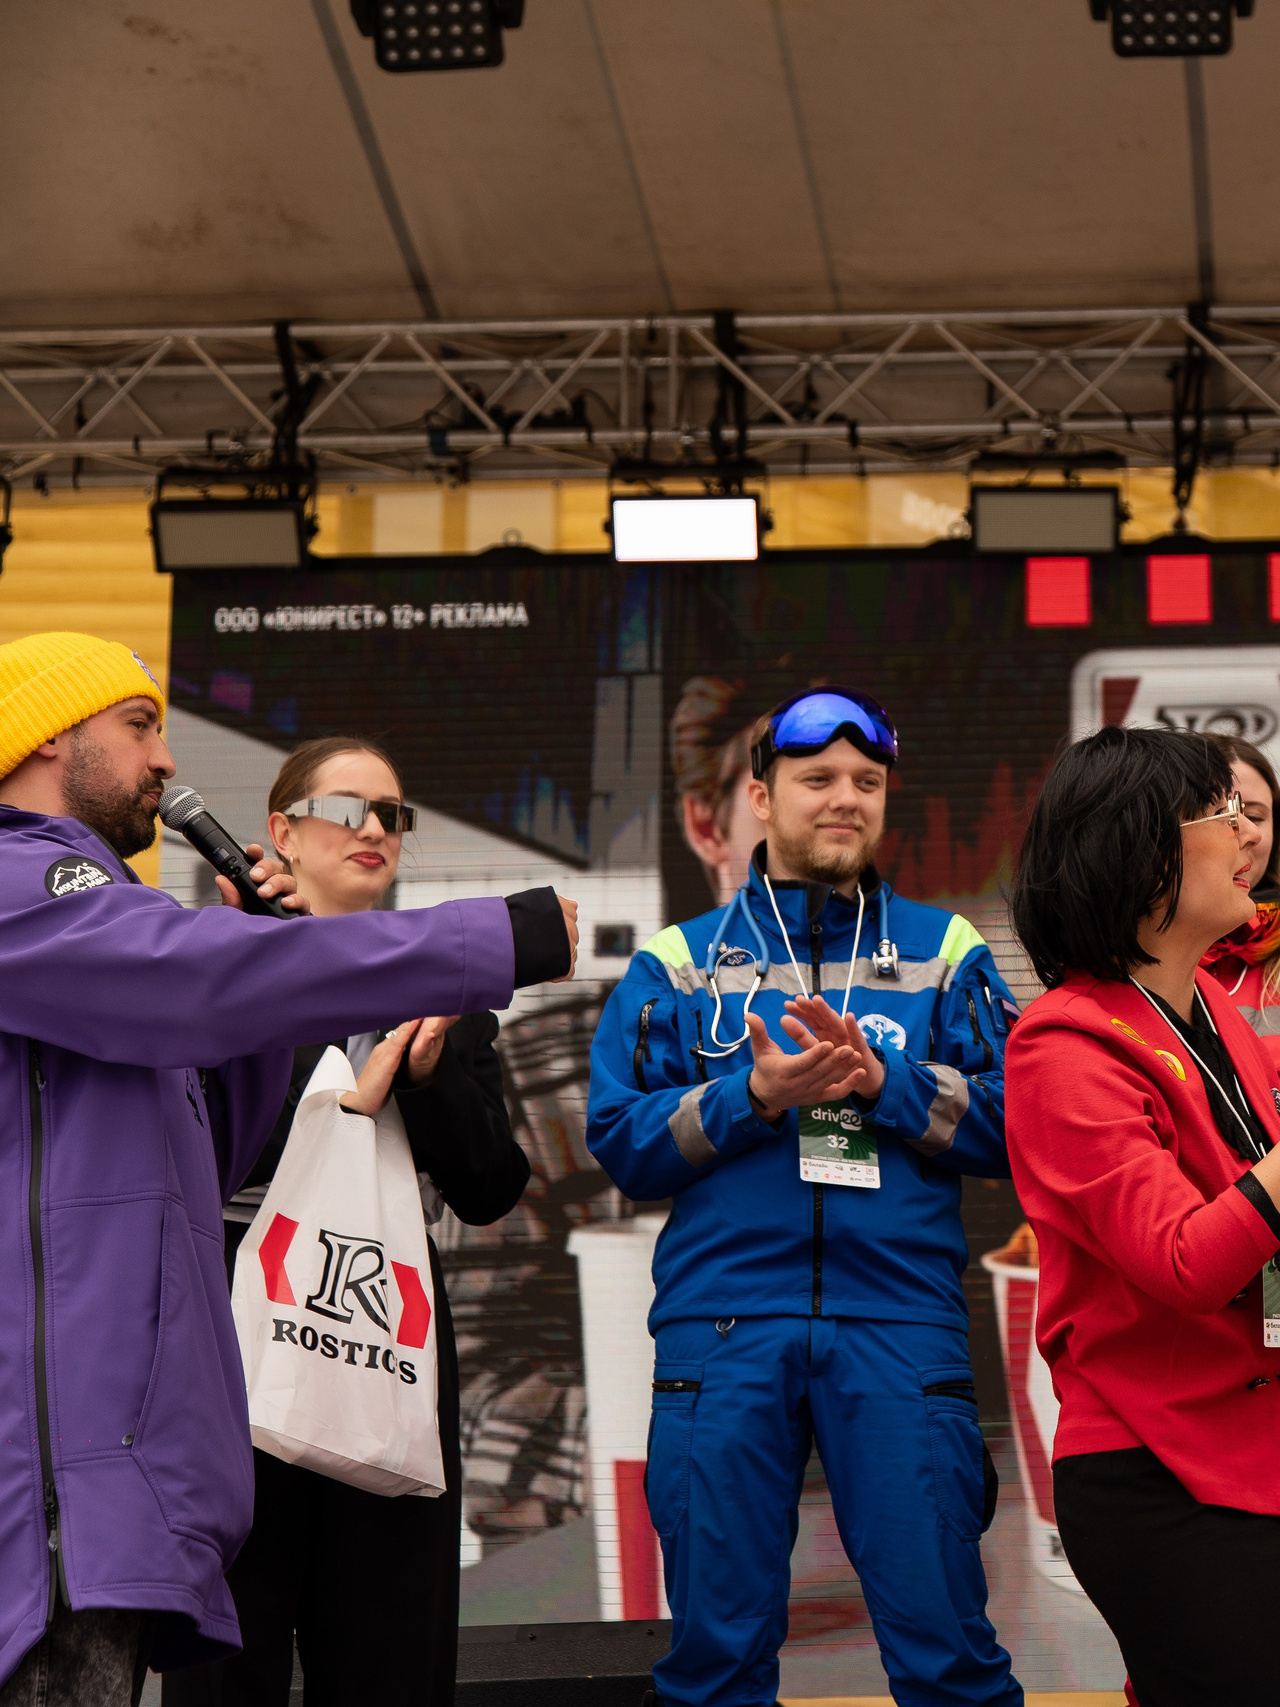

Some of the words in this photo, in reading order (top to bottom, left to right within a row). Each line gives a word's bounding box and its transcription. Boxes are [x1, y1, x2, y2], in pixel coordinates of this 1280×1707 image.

[214, 607, 259, 632] ООО
[430, 602, 530, 628] РЕКЛАМА
[827, 1134, 849, 1150] 32
